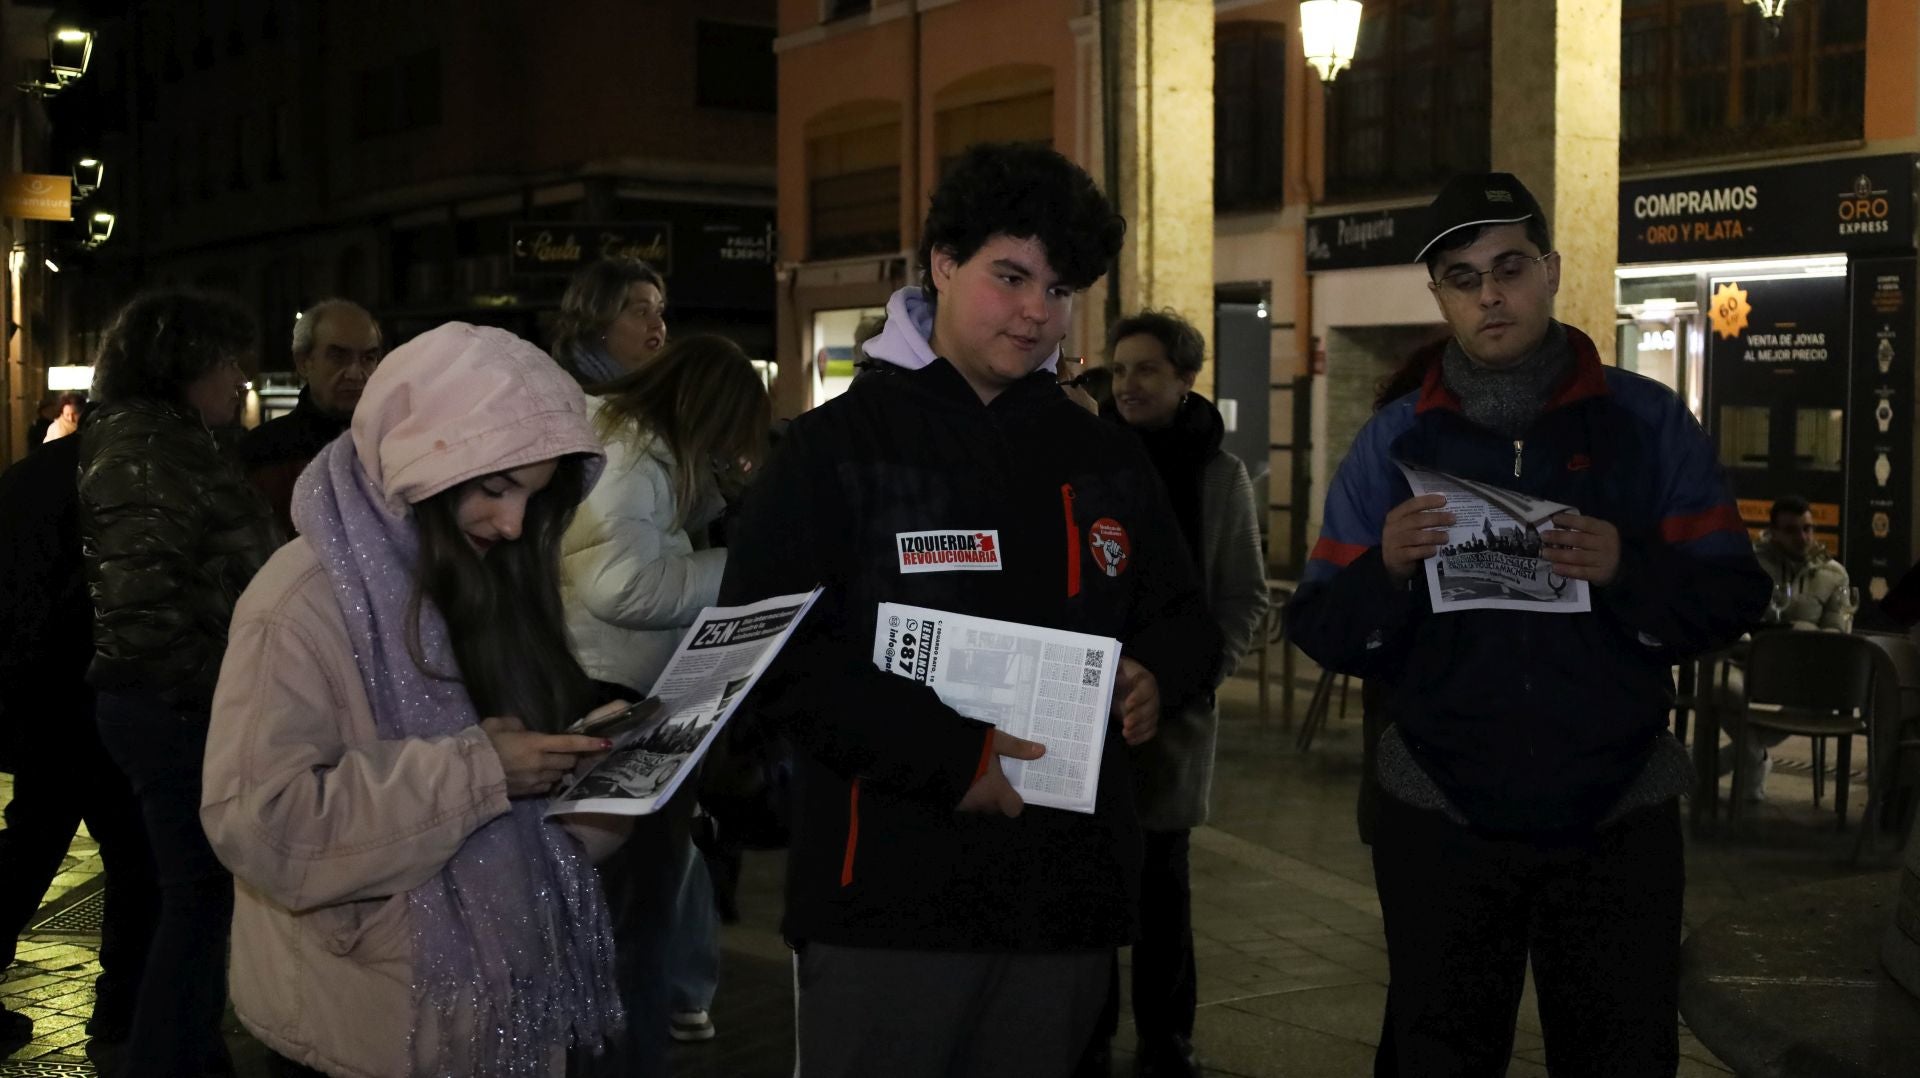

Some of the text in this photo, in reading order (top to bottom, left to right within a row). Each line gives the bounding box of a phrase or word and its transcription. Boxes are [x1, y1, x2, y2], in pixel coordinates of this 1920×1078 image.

[1634, 184, 1758, 219] COMPRAMOS
[1838, 198, 1889, 220] ORO
[1646, 219, 1744, 245] ORO Y PLATA
[1838, 220, 1889, 235] EXPRESS
[1719, 297, 1738, 319] 60
[1746, 333, 1825, 347] VENTA DE JOYAS
[1744, 348, 1828, 362] AL MEJOR PRECIO
[900, 535, 977, 553] IZQUIERDA
[903, 550, 998, 565] REVOLUCIONARIA
[694, 620, 742, 646] 25N
[934, 627, 942, 655] EDUARDO
[899, 633, 917, 675] 687
